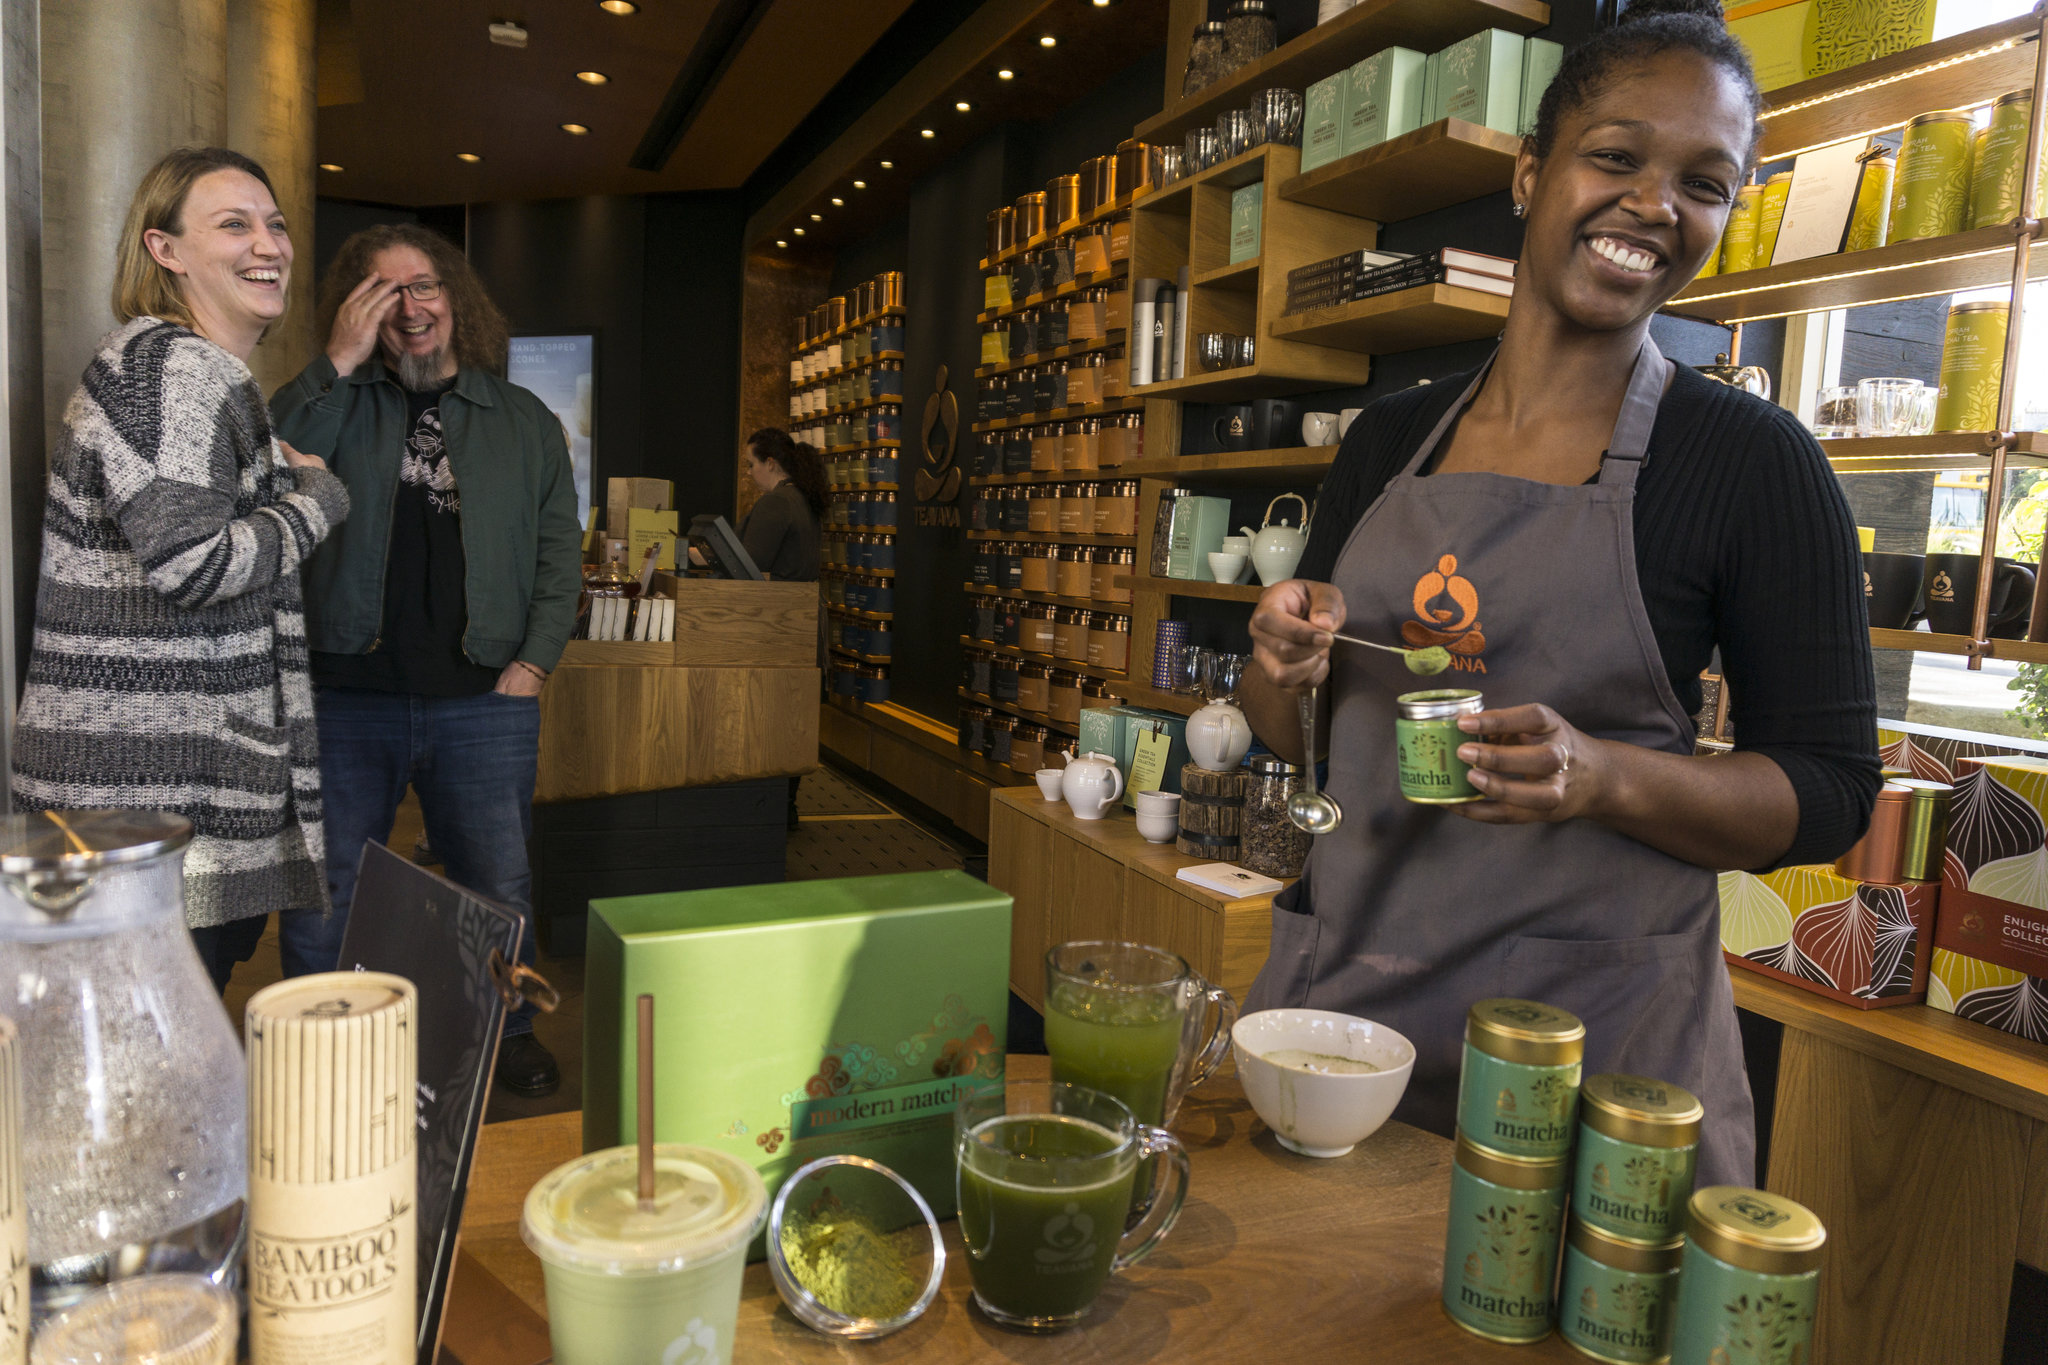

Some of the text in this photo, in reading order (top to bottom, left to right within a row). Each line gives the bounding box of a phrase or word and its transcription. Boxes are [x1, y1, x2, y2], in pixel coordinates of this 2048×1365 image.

[2008, 123, 2026, 132] TEA
[1920, 144, 1937, 153] TEA
[1356, 263, 1405, 282] THE NEW TEA COMPANION
[1355, 291, 1364, 299] THE
[1364, 288, 1374, 297] NEW
[1374, 286, 1382, 295] TEA
[1381, 281, 1407, 293] COMPANION
[510, 342, 577, 353] HAND-TOPPED
[1962, 334, 1980, 343] TEA
[510, 354, 546, 365] SCONES
[809, 1081, 977, 1128] modern matcha
[1494, 1119, 1569, 1142] matcha
[1589, 1193, 1670, 1225] matcha
[254, 1226, 397, 1276] BAMBOO
[254, 1253, 397, 1302] TEA TOOLS
[1460, 1284, 1545, 1319] matcha
[1577, 1315, 1656, 1348] matcha
